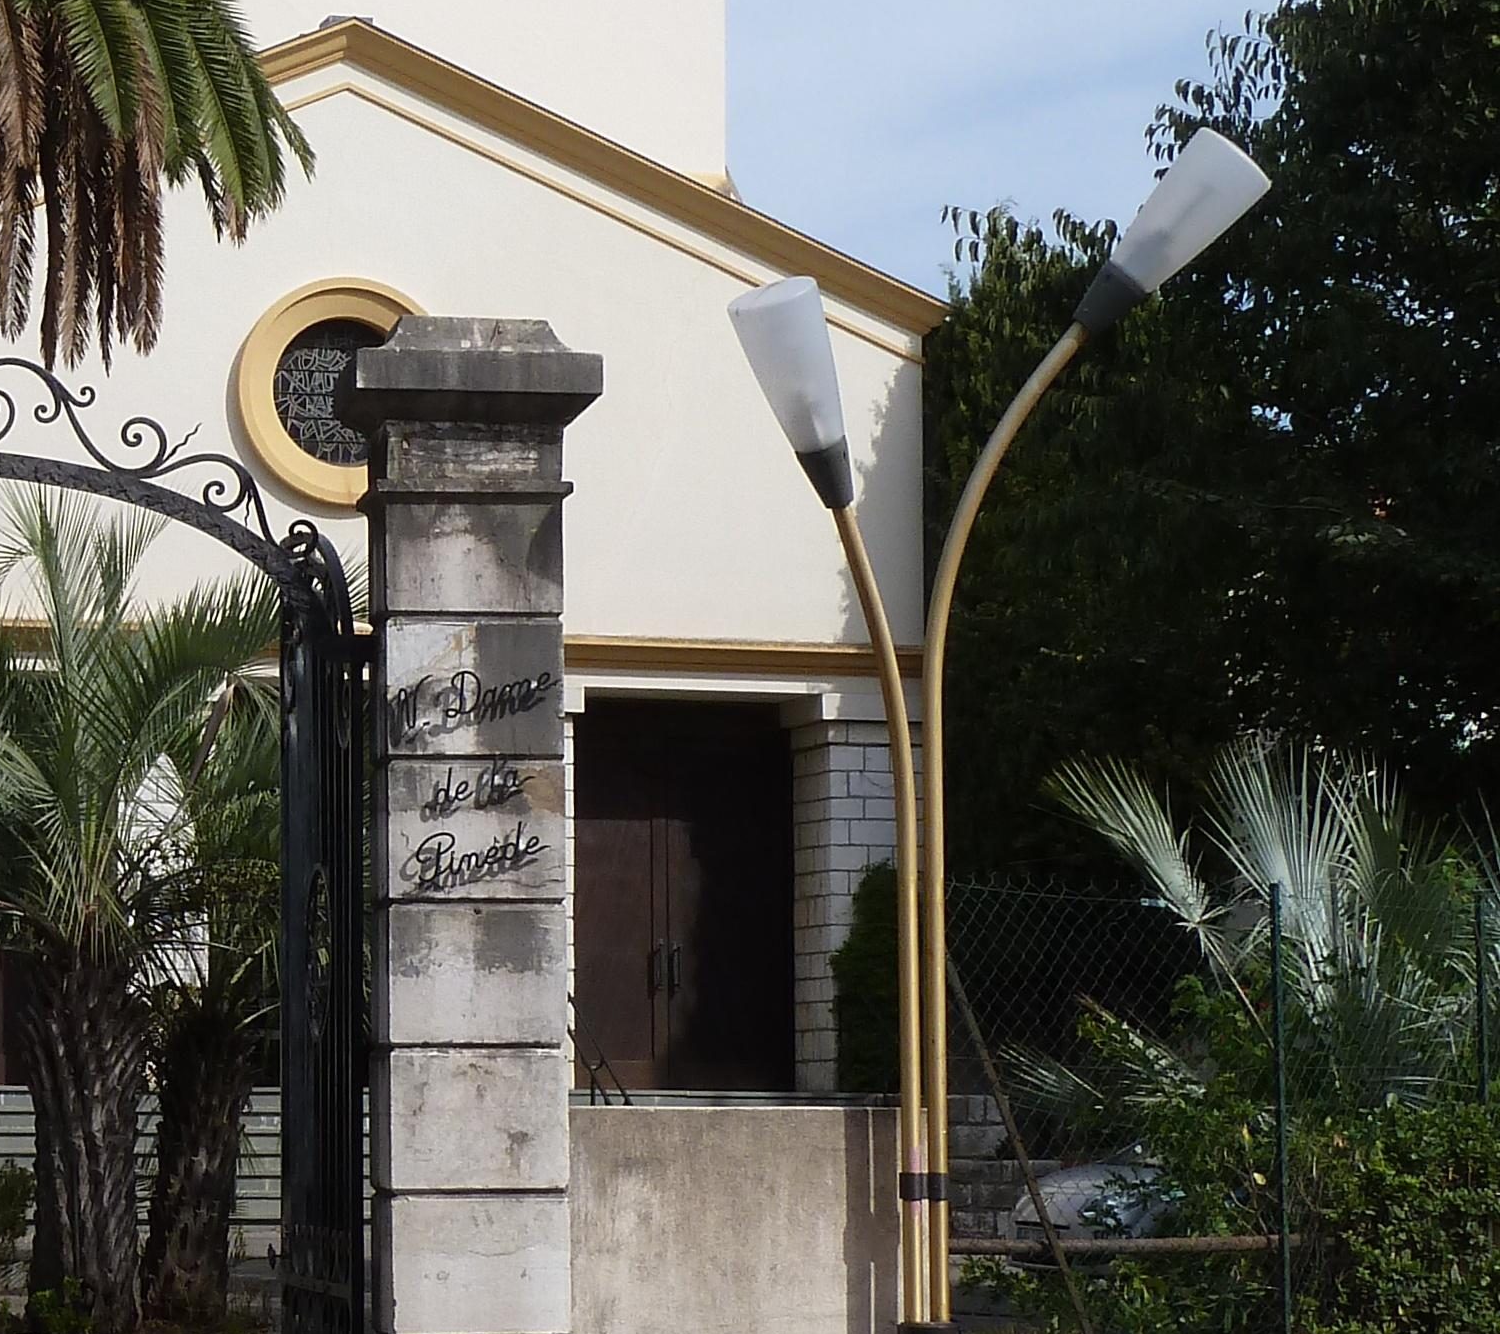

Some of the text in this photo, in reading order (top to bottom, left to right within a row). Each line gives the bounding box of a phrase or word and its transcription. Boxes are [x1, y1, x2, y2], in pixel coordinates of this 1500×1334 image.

[446, 671, 561, 718] Dame
[436, 752, 536, 804] de la
[415, 821, 551, 882] Pinède
